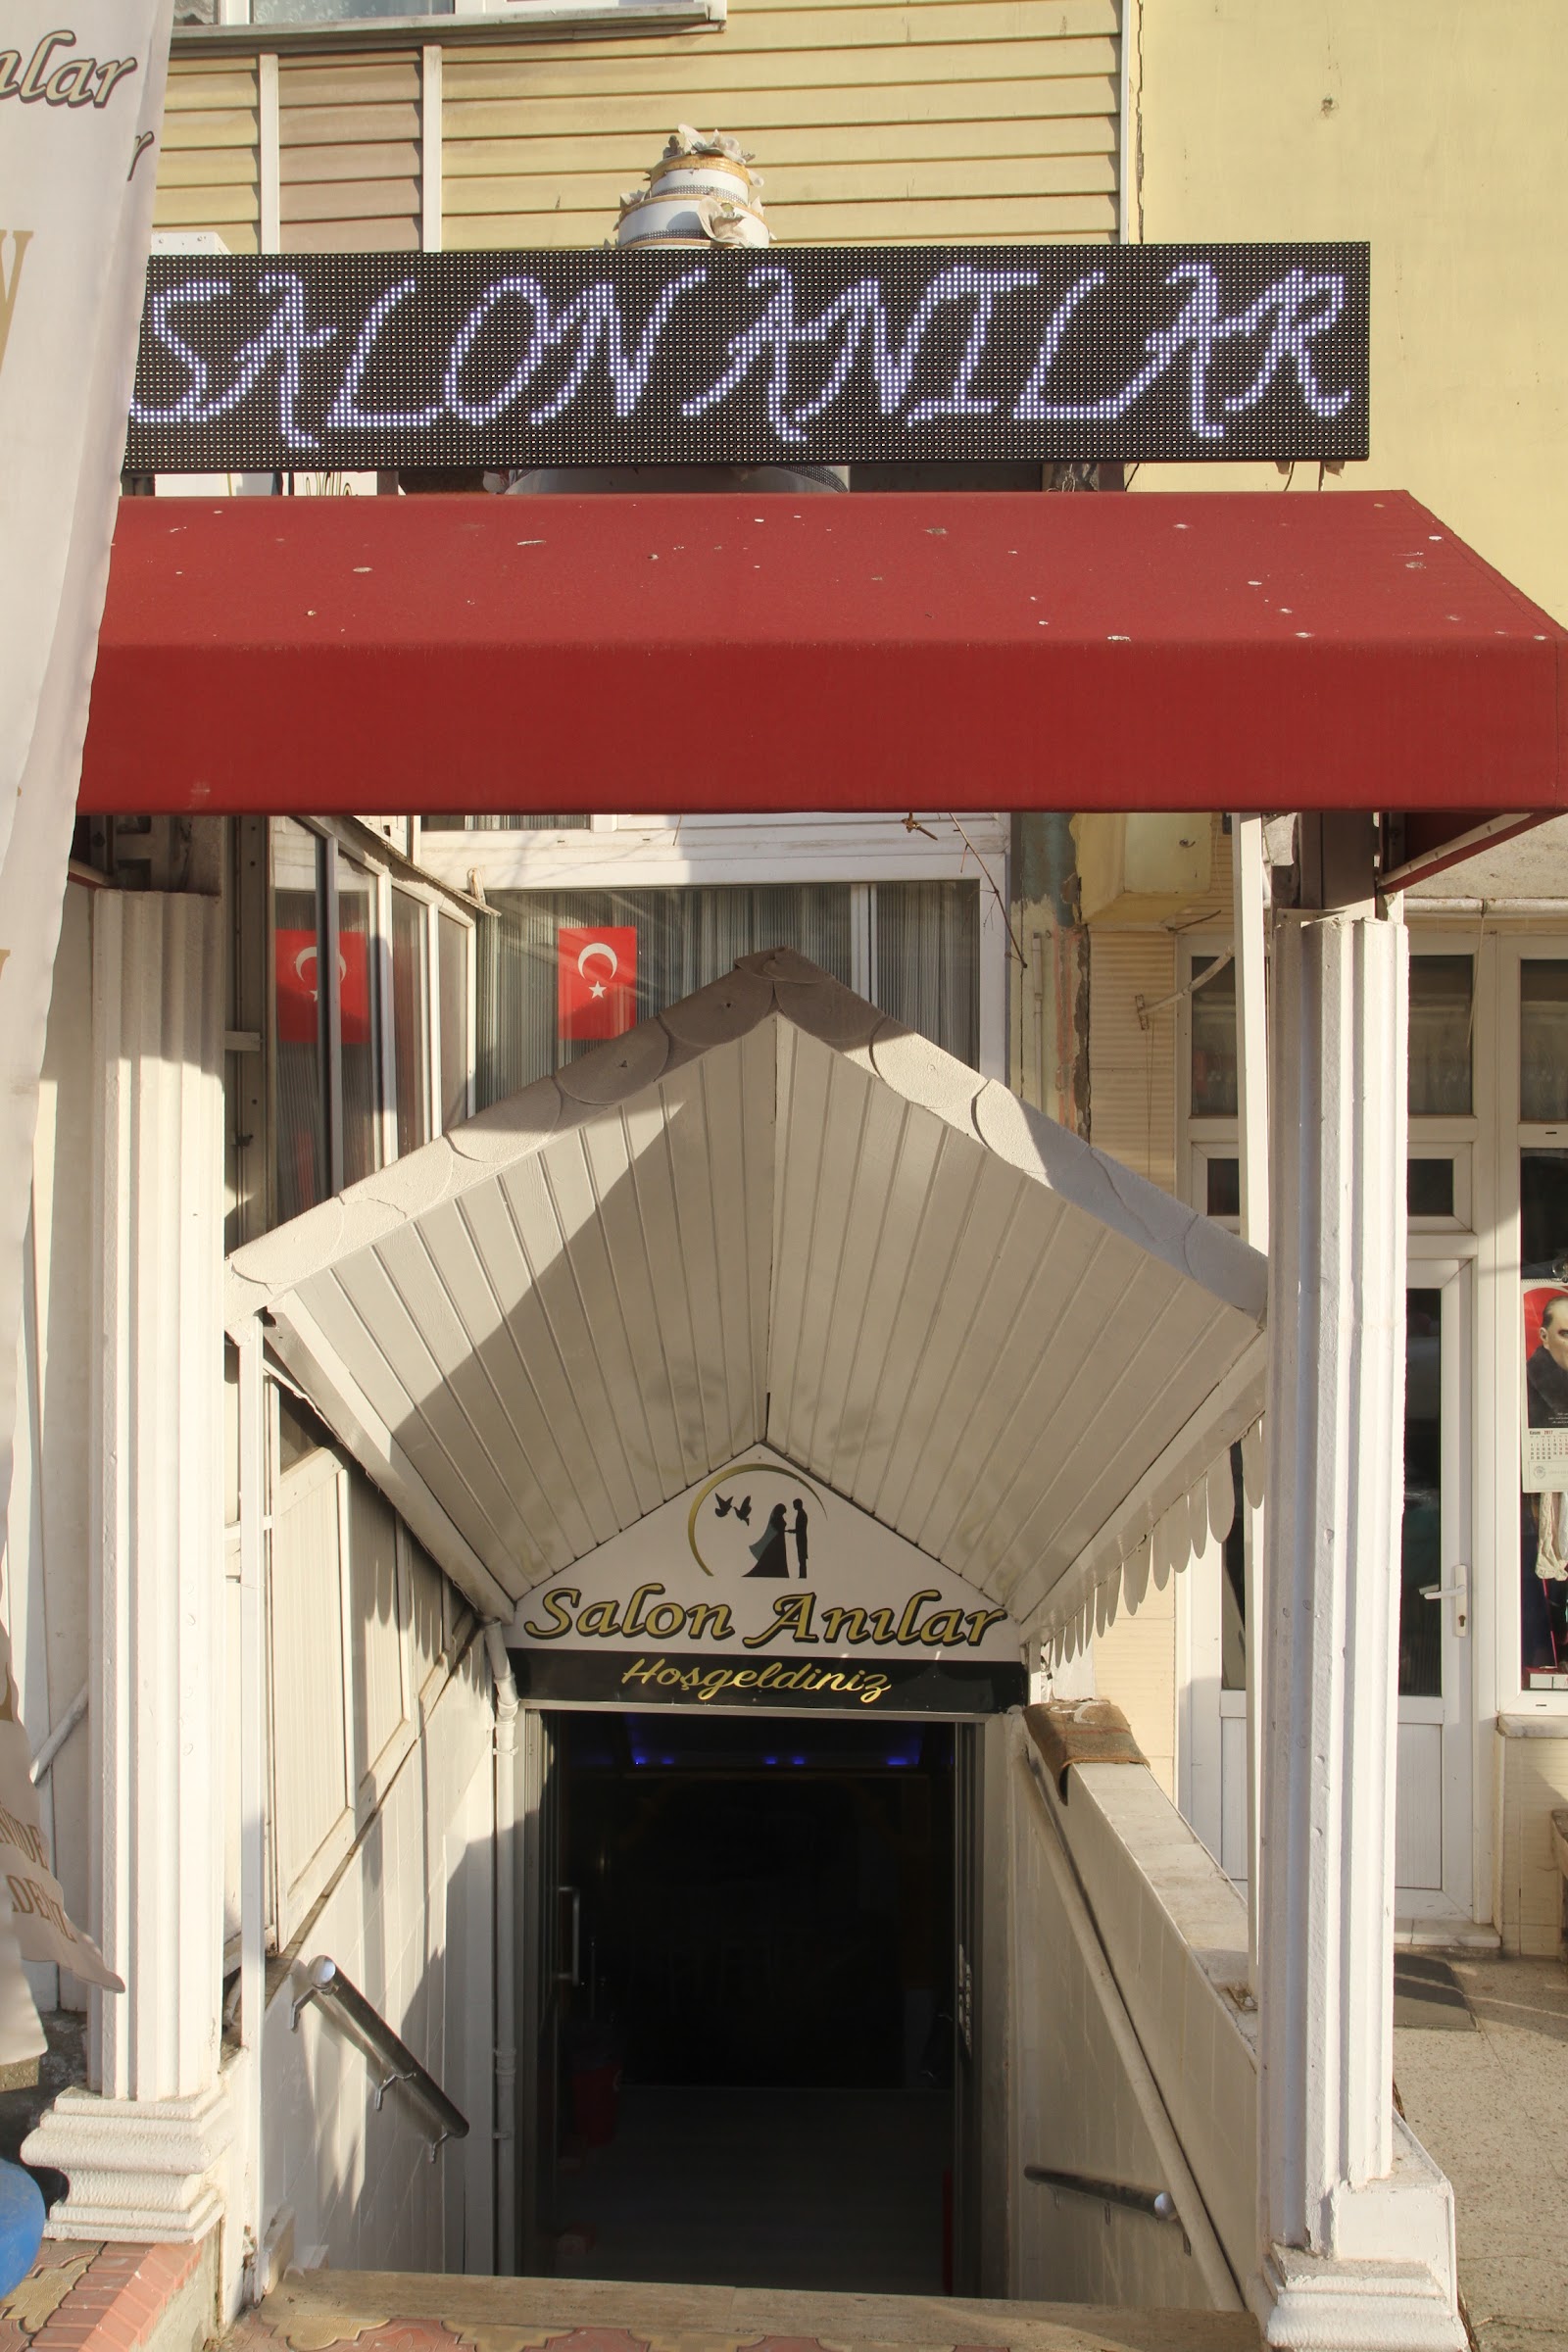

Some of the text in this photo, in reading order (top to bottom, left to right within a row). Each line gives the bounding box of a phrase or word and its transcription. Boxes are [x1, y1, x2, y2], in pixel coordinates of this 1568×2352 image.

[524, 1583, 1008, 1648] Salon Anılar
[620, 1658, 893, 1703] Hoşgeldiniz
